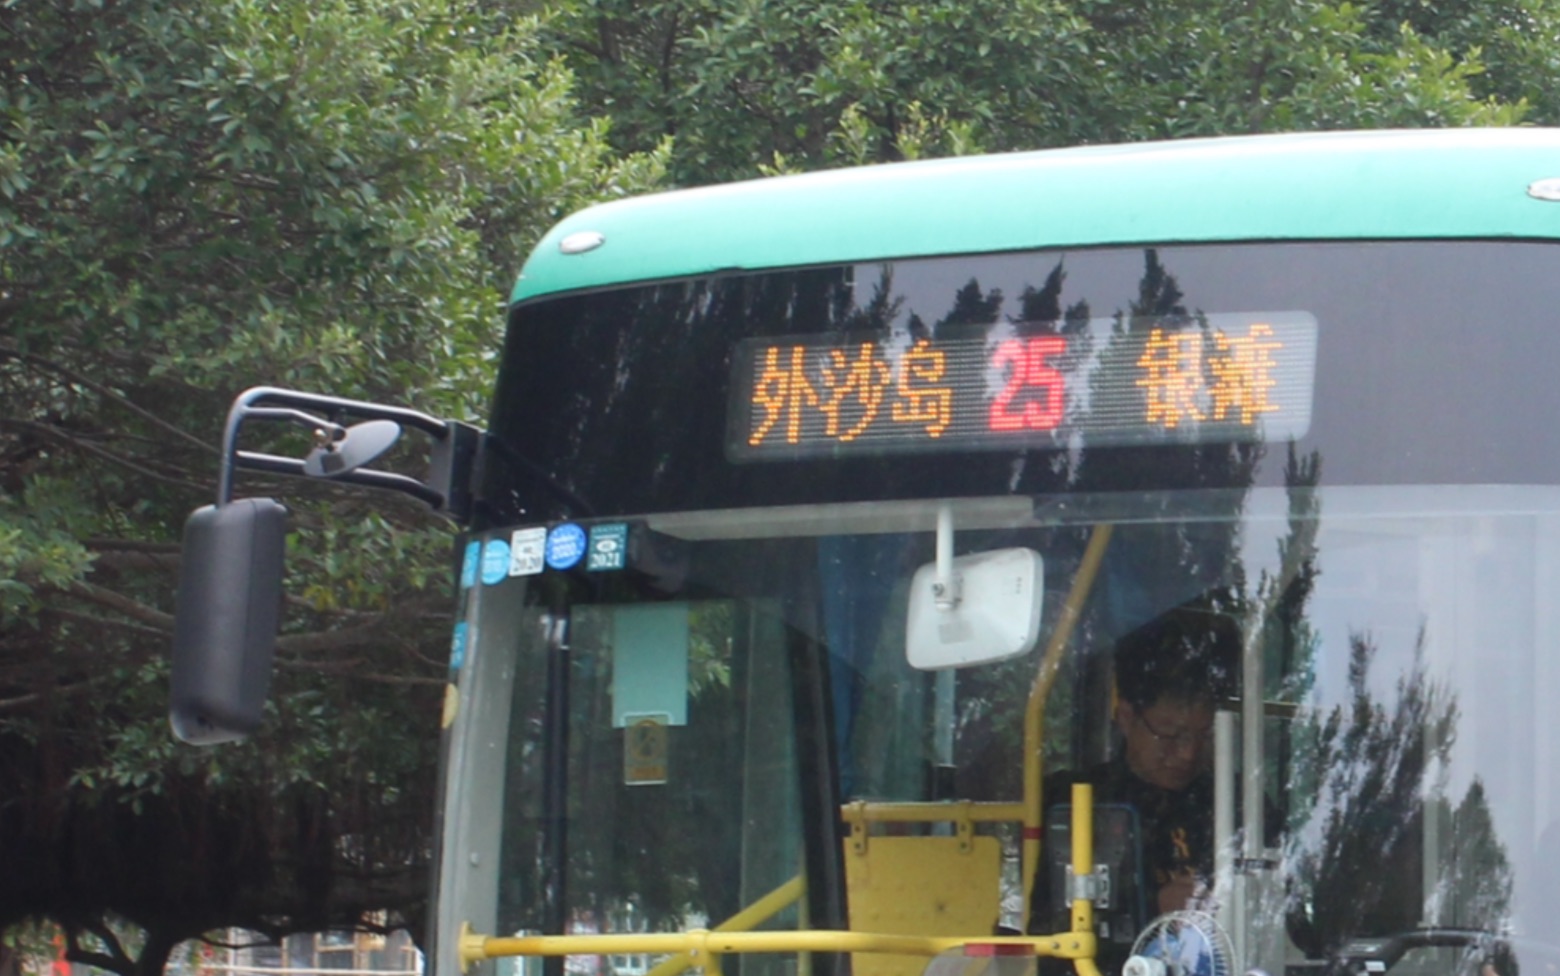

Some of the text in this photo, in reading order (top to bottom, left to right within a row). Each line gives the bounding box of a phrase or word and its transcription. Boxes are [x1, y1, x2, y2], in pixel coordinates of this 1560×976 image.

[750, 324, 1283, 445] 外沙岛 25 银滩
[590, 552, 620, 568] 2021
